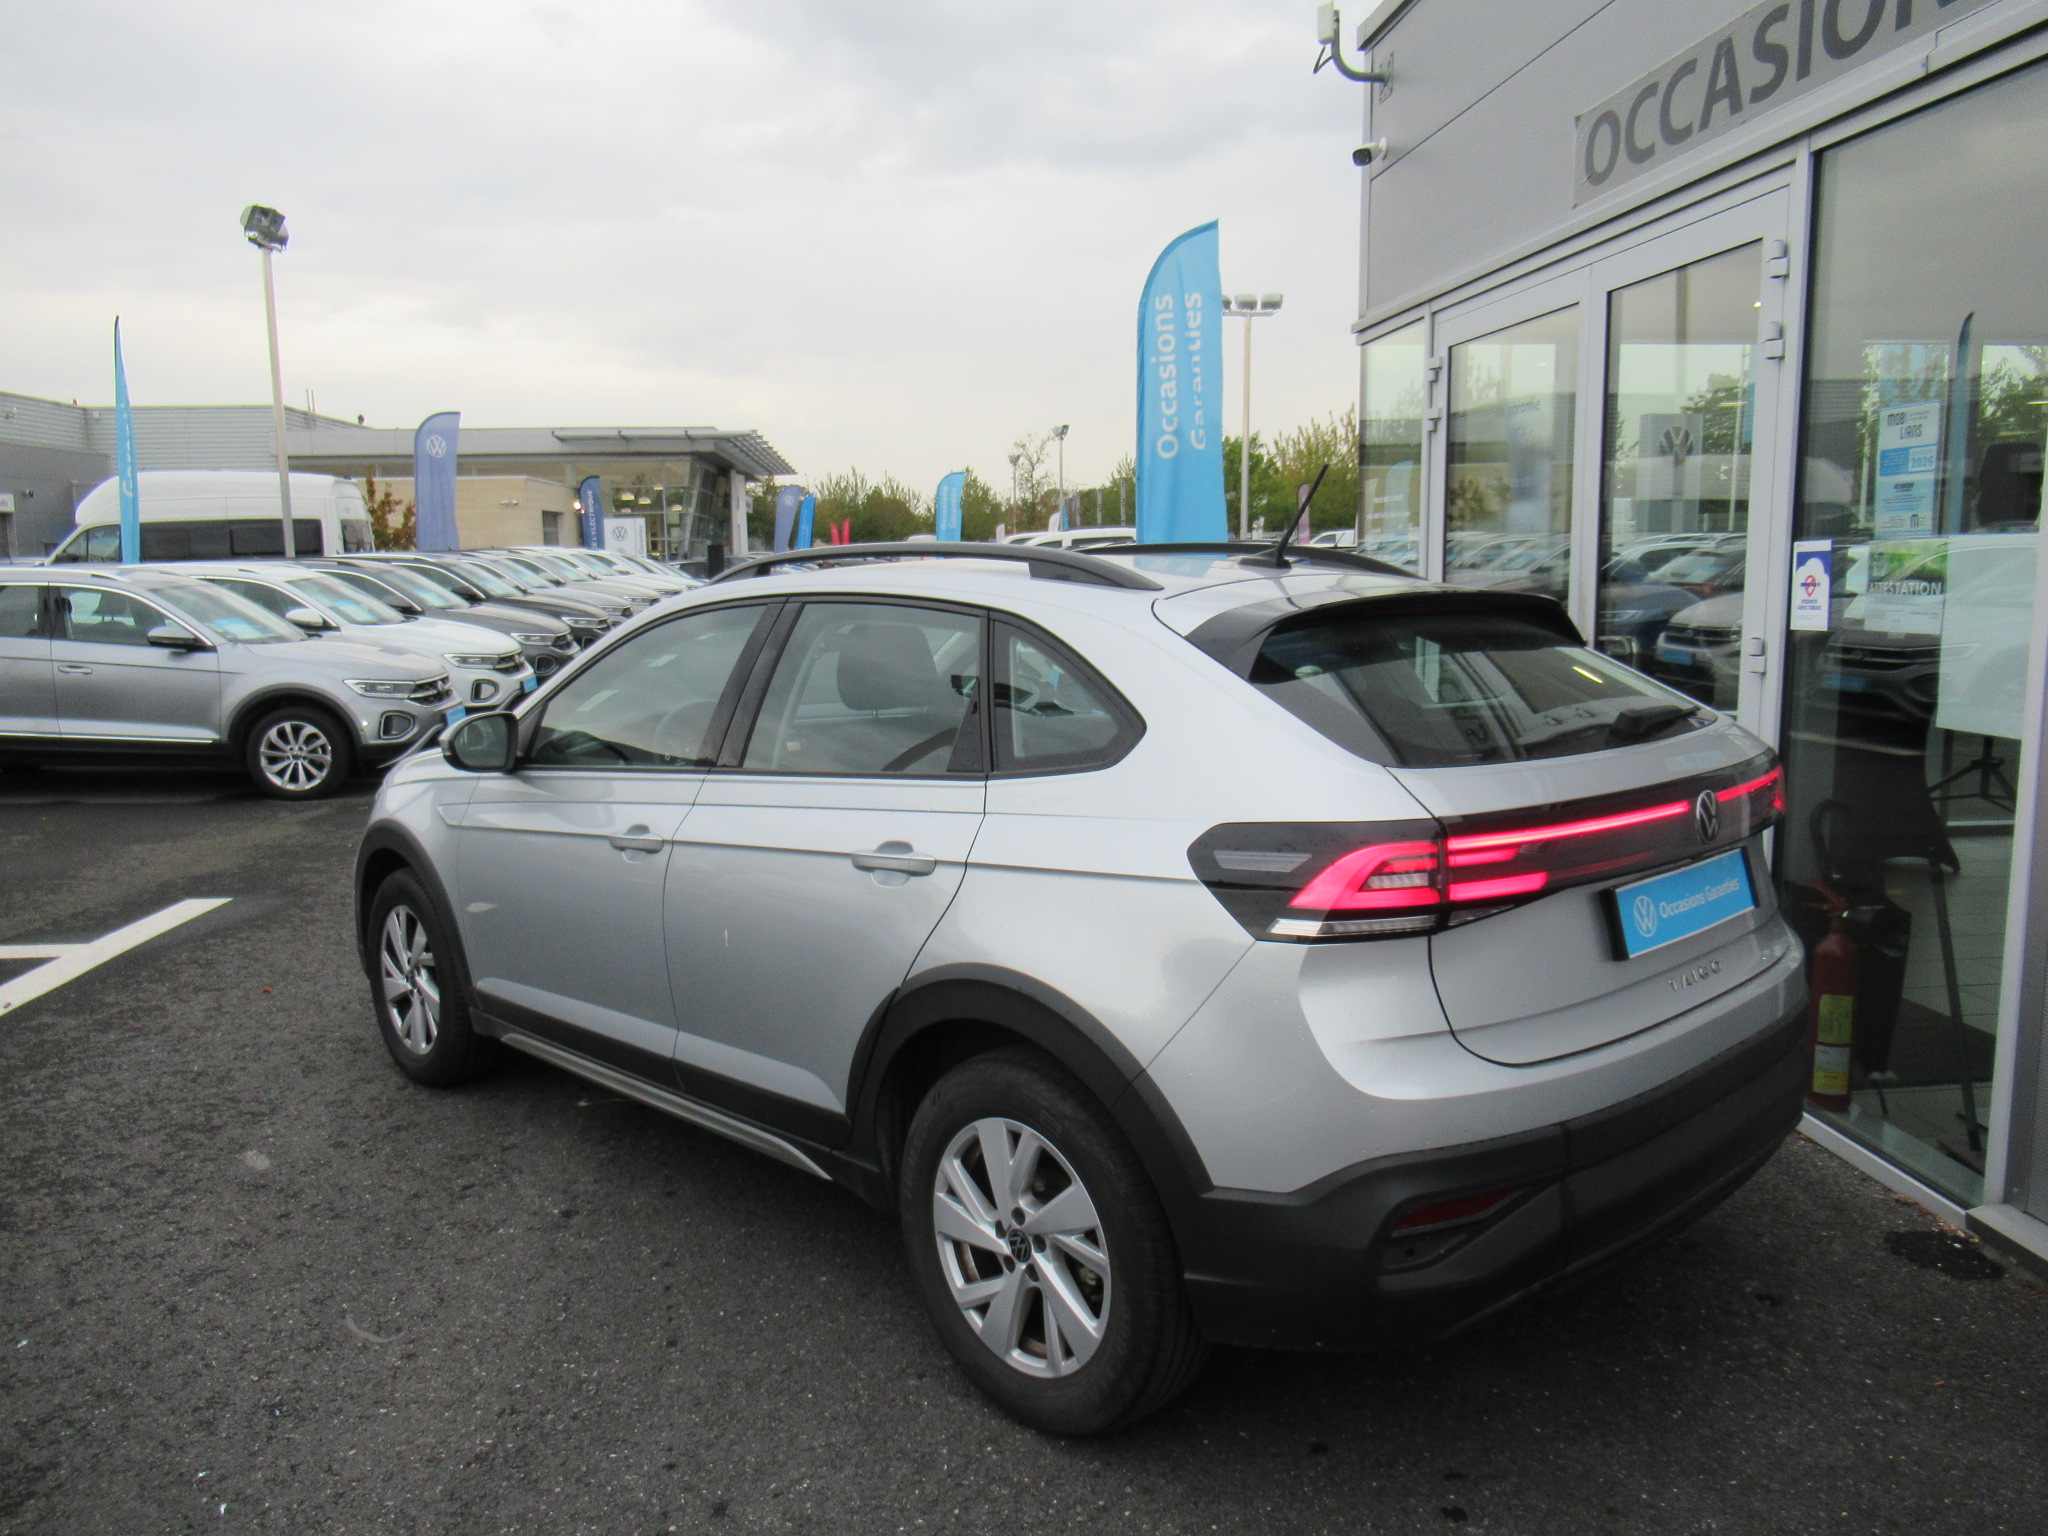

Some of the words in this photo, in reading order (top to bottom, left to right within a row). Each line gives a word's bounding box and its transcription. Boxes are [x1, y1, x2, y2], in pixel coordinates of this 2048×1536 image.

[1584, 0, 1958, 187] OCCASIO
[1151, 294, 1180, 460] Occasions
[1659, 892, 1706, 918] Occasions
[1705, 878, 1740, 901] Garanties
[1667, 959, 1721, 992] TAIGO
